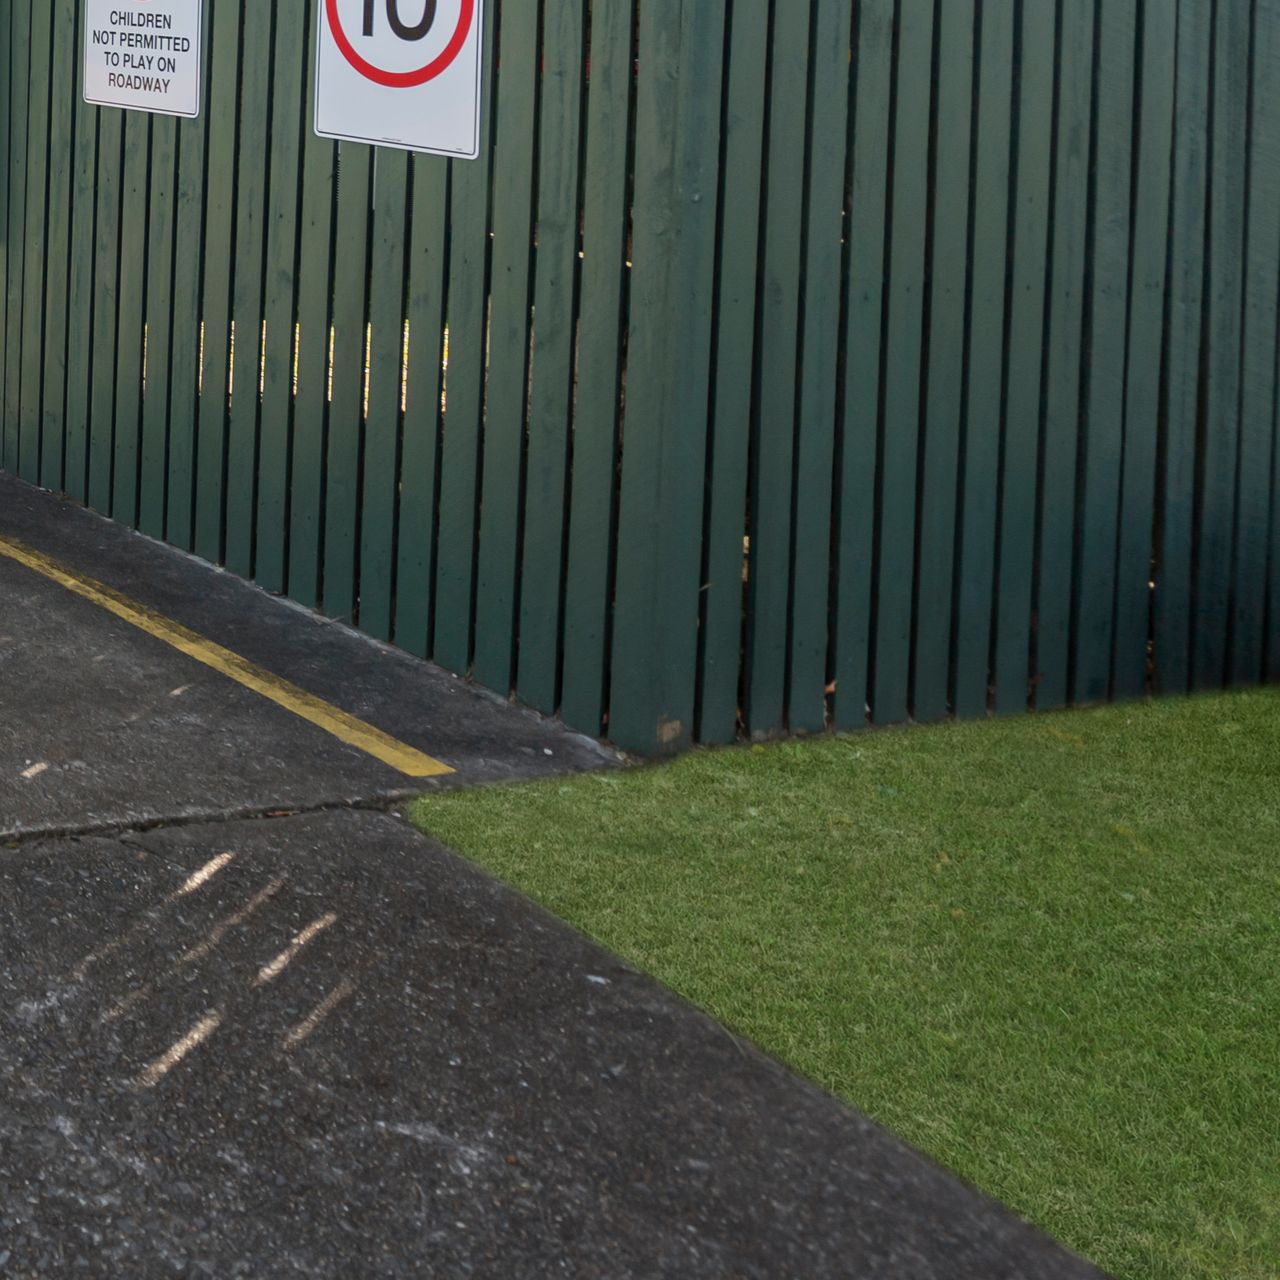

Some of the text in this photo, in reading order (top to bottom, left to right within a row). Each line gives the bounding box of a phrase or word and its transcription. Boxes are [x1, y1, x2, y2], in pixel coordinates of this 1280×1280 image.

[110, 11, 172, 29] CHILDREN
[92, 30, 191, 53] NOT PERMITTED
[104, 51, 176, 73] TO PLAY ON
[108, 72, 171, 94] ROADWAY
